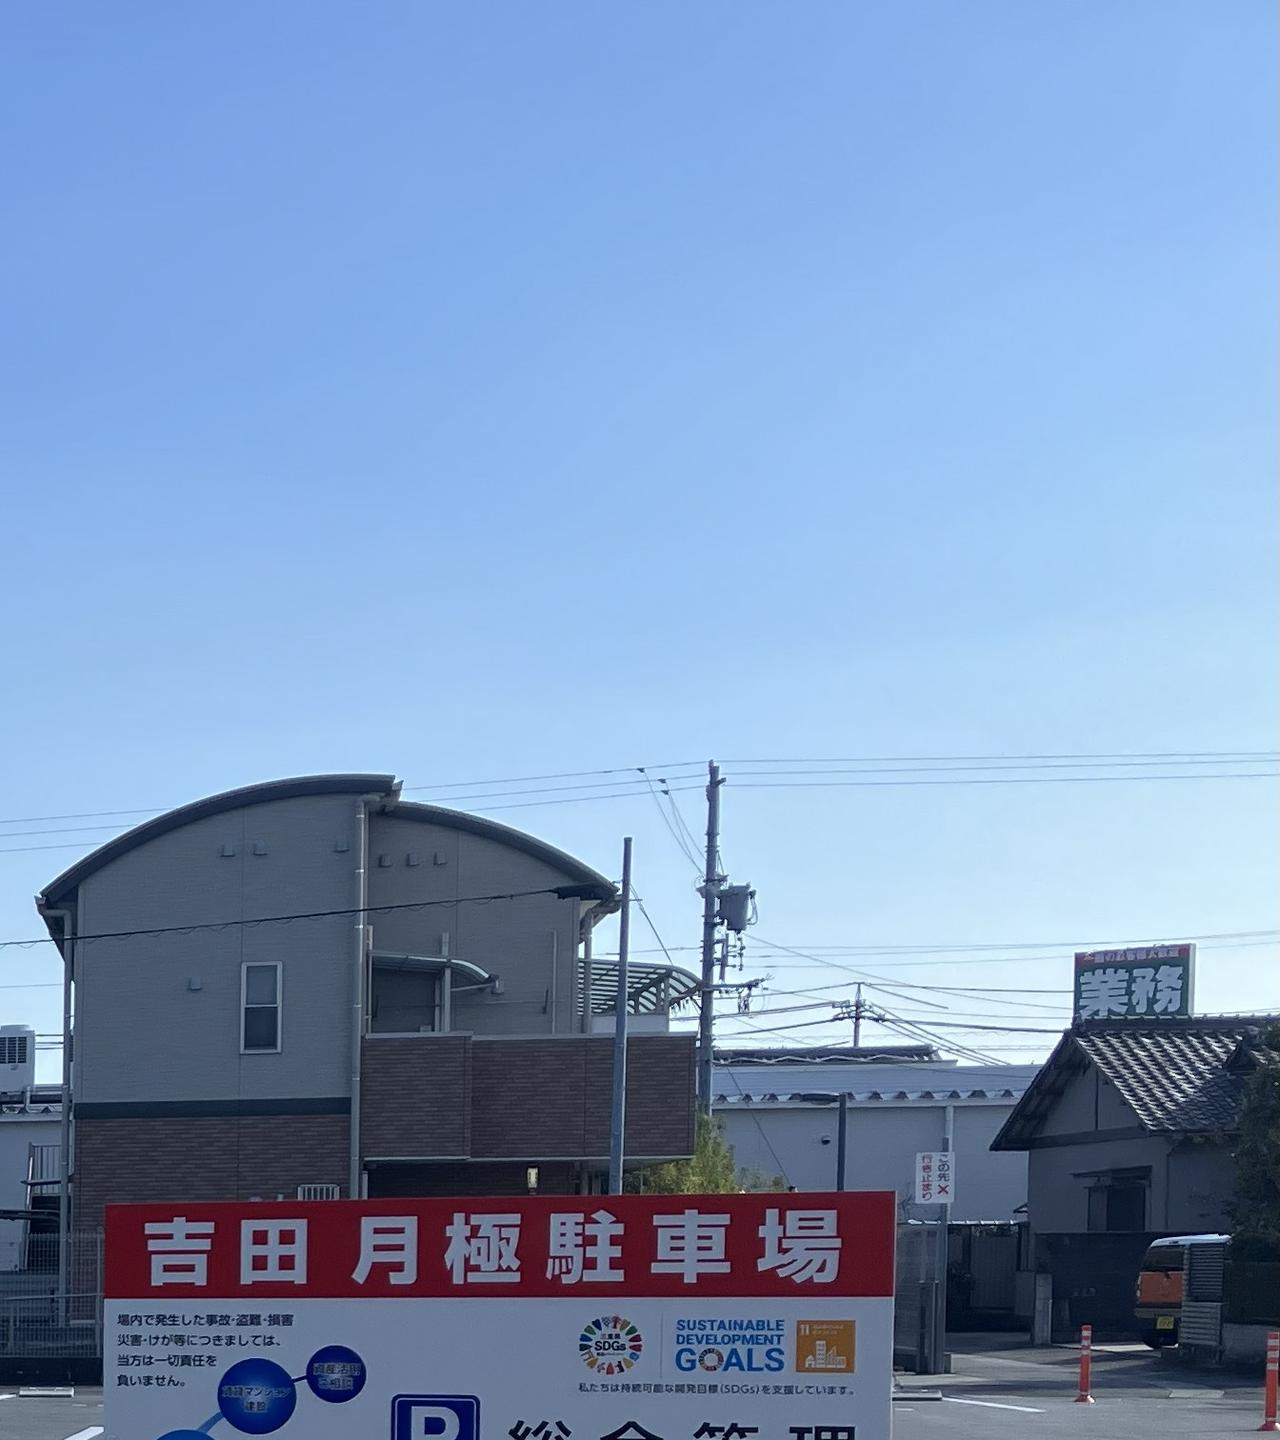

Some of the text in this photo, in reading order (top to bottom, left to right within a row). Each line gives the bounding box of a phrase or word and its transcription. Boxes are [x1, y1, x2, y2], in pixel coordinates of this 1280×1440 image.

[1080, 965, 1184, 1018] 業務
[676, 1319, 785, 1331] SUSTAINABLE
[594, 1340, 627, 1352] SDGs
[676, 1334, 784, 1346] DEVELOPMENT
[117, 1354, 217, 1367] 当方は一切責任を
[117, 1375, 186, 1387] 負いません。
